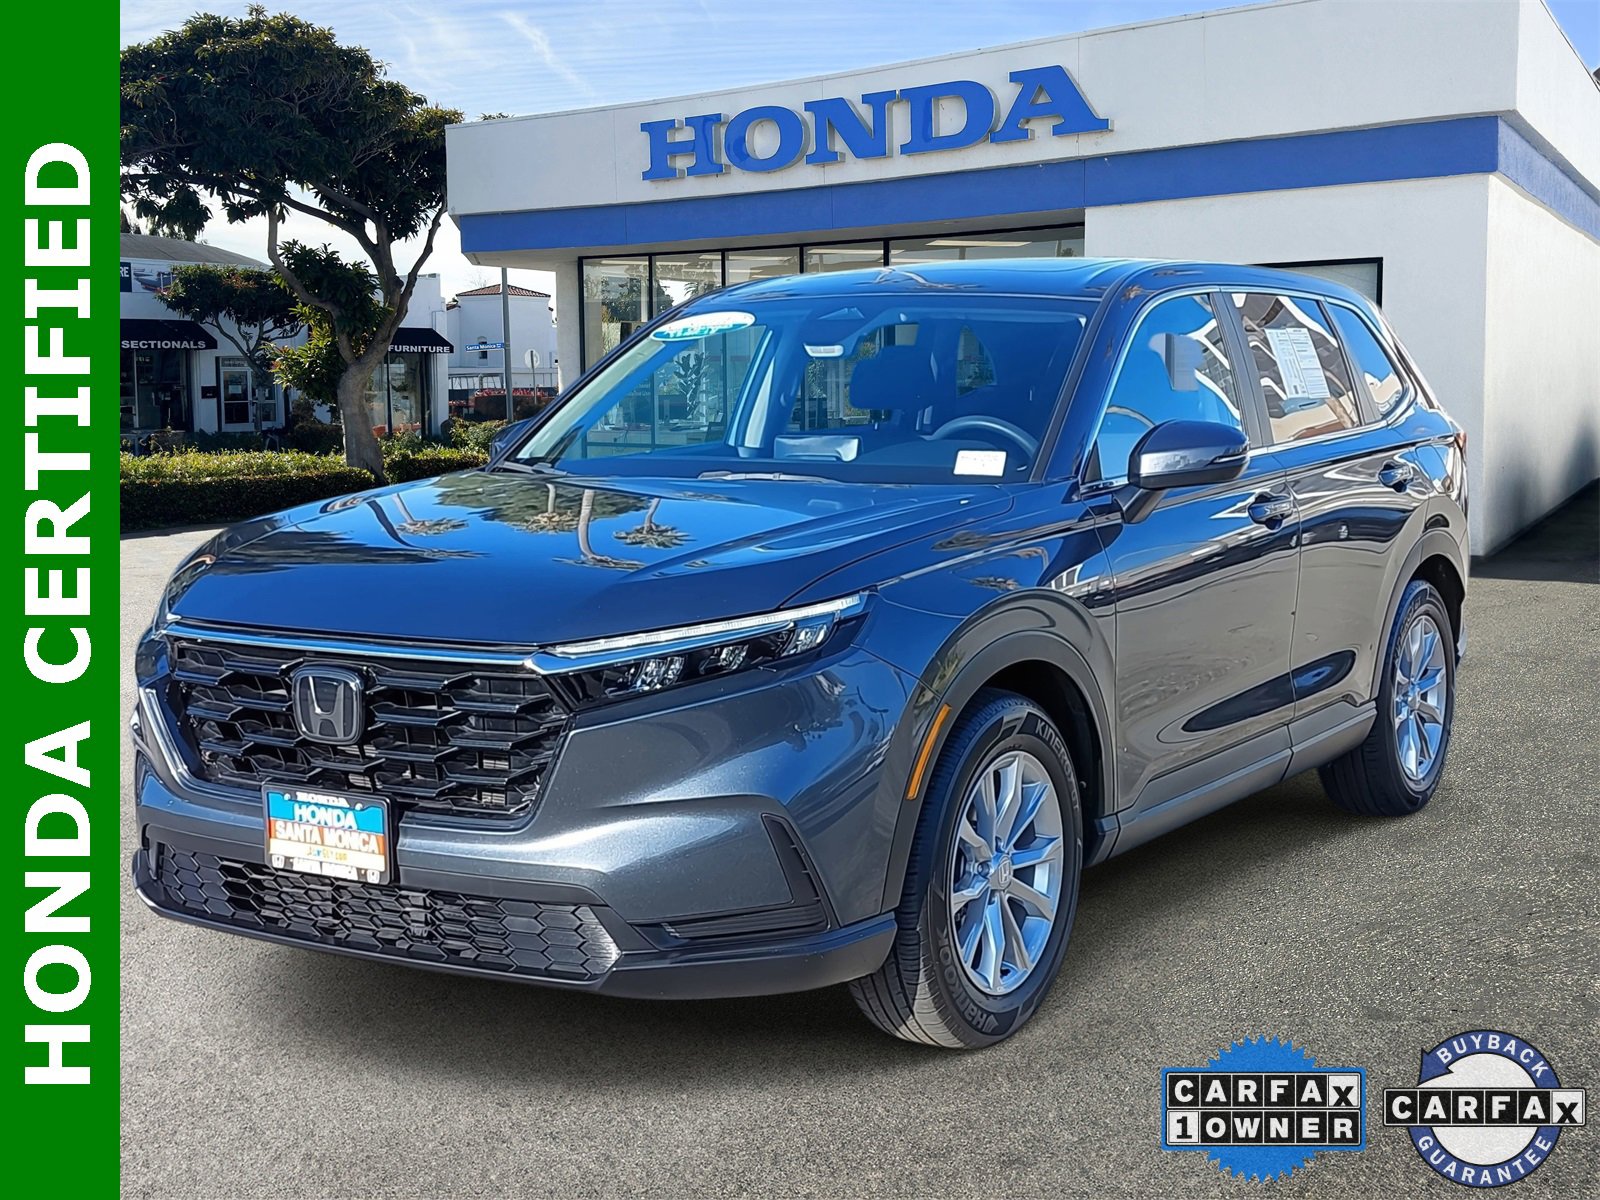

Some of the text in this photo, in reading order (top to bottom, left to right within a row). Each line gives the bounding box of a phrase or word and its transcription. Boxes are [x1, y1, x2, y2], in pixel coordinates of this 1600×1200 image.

[641, 65, 1114, 181] HONDA
[121, 340, 206, 349] SECTIONALS
[388, 344, 450, 353] FURNITURE
[294, 803, 358, 830] HONDA
[275, 820, 322, 845] SANTA
[323, 827, 380, 855] MONICA
